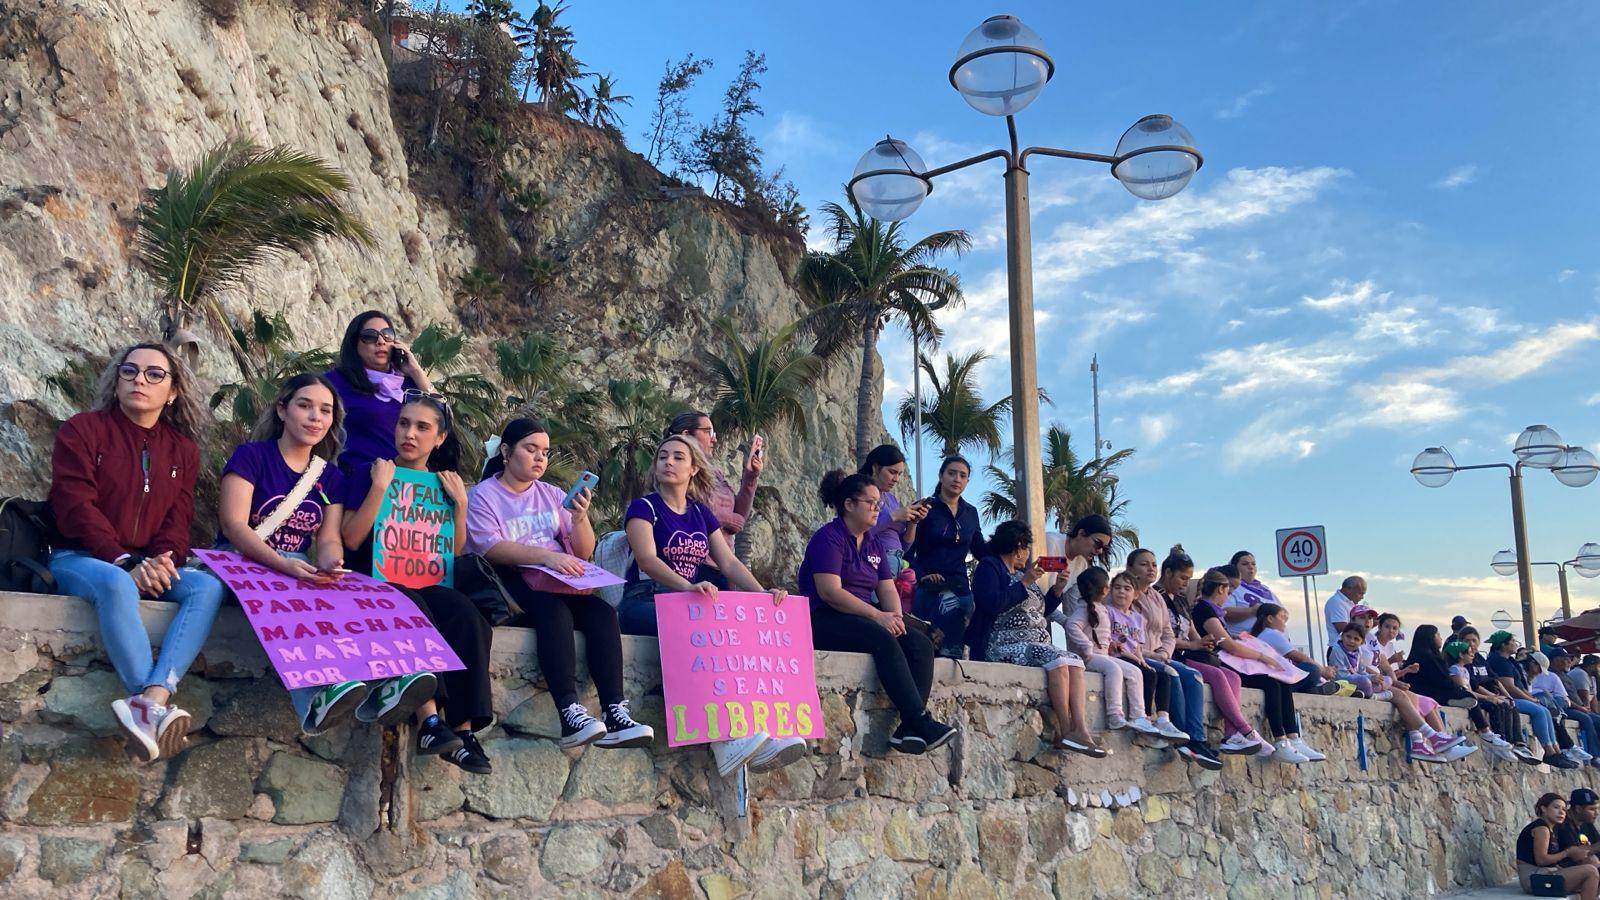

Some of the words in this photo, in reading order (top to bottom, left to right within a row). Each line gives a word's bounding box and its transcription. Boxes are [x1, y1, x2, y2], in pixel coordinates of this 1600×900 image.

[388, 479, 405, 501] SI
[413, 483, 451, 505] FAL
[391, 502, 452, 526] MAÑANA
[283, 533, 301, 544] SIN
[375, 522, 453, 554] ¡QUEMEN
[678, 537, 707, 549] LIBRES
[1290, 539, 1313, 557] 40
[228, 579, 290, 592] MIS
[243, 598, 336, 615] PARA
[353, 597, 396, 610] NO
[688, 602, 787, 625] DESEO
[260, 615, 433, 642] MARCHAR
[690, 628, 742, 648] QUE
[757, 629, 793, 648] MIS
[277, 636, 445, 664] MAÑANA
[691, 654, 800, 675] ALUMNAS
[282, 665, 348, 689] POR
[713, 676, 784, 696] SEAN
[672, 700, 814, 742] LIBRES
